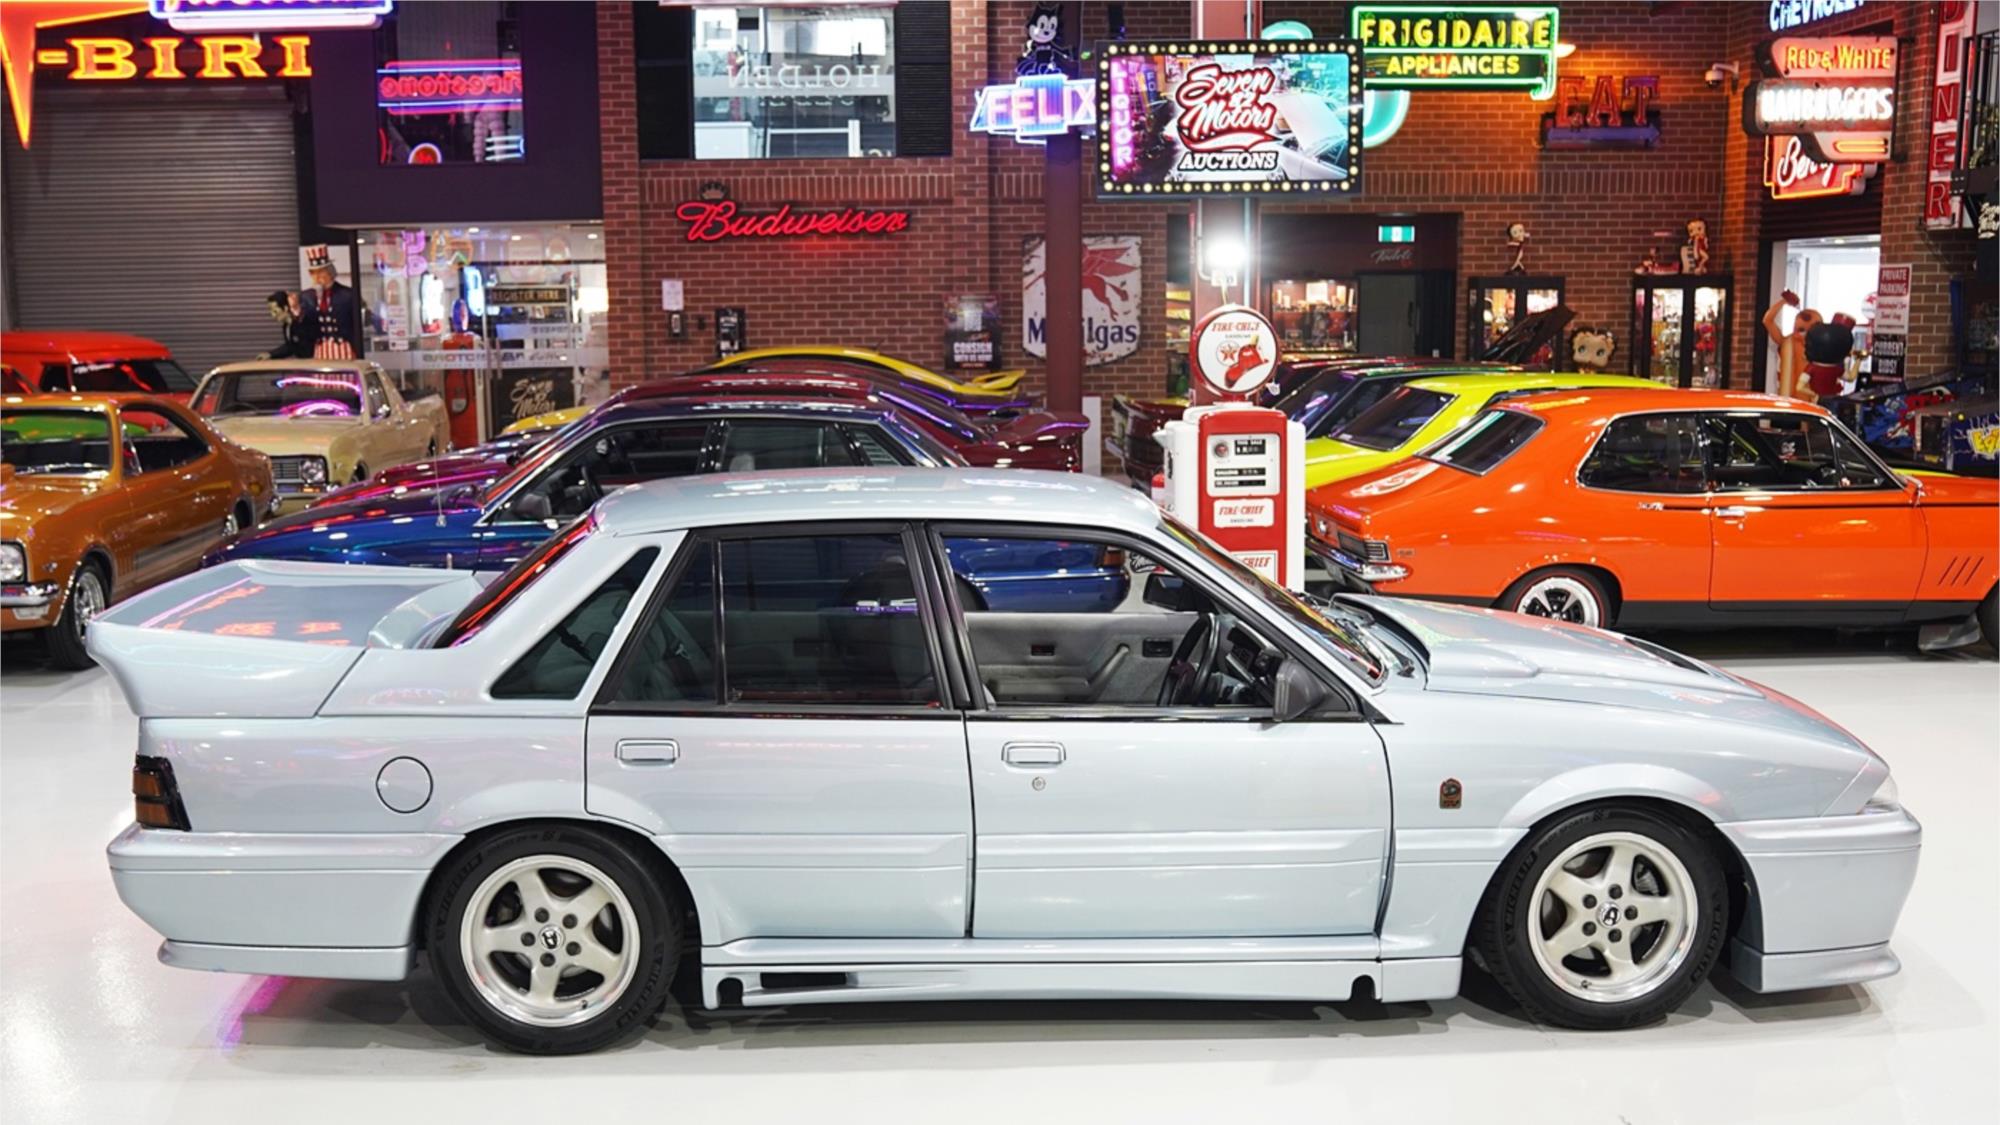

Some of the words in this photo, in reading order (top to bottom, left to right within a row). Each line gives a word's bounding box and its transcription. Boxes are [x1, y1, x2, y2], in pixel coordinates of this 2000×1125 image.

[1360, 17, 1551, 48] FRIGIDAIRE
[1386, 55, 1521, 75] APPLIANCES
[1786, 46, 1820, 69] RED
[1820, 50, 1832, 69] &
[1836, 45, 1892, 69] WHITE
[1179, 66, 1271, 107] Seven
[1556, 75, 1660, 127] EAT
[1761, 86, 1893, 122] HAMBURGERS
[987, 82, 1096, 129] FELIX
[1111, 61, 1133, 166] LIQUOR
[1180, 101, 1274, 139] Motors
[1179, 152, 1277, 169] AUCTIONS
[676, 200, 908, 242] Budweiser
[1027, 316, 1138, 352] Mlgas
